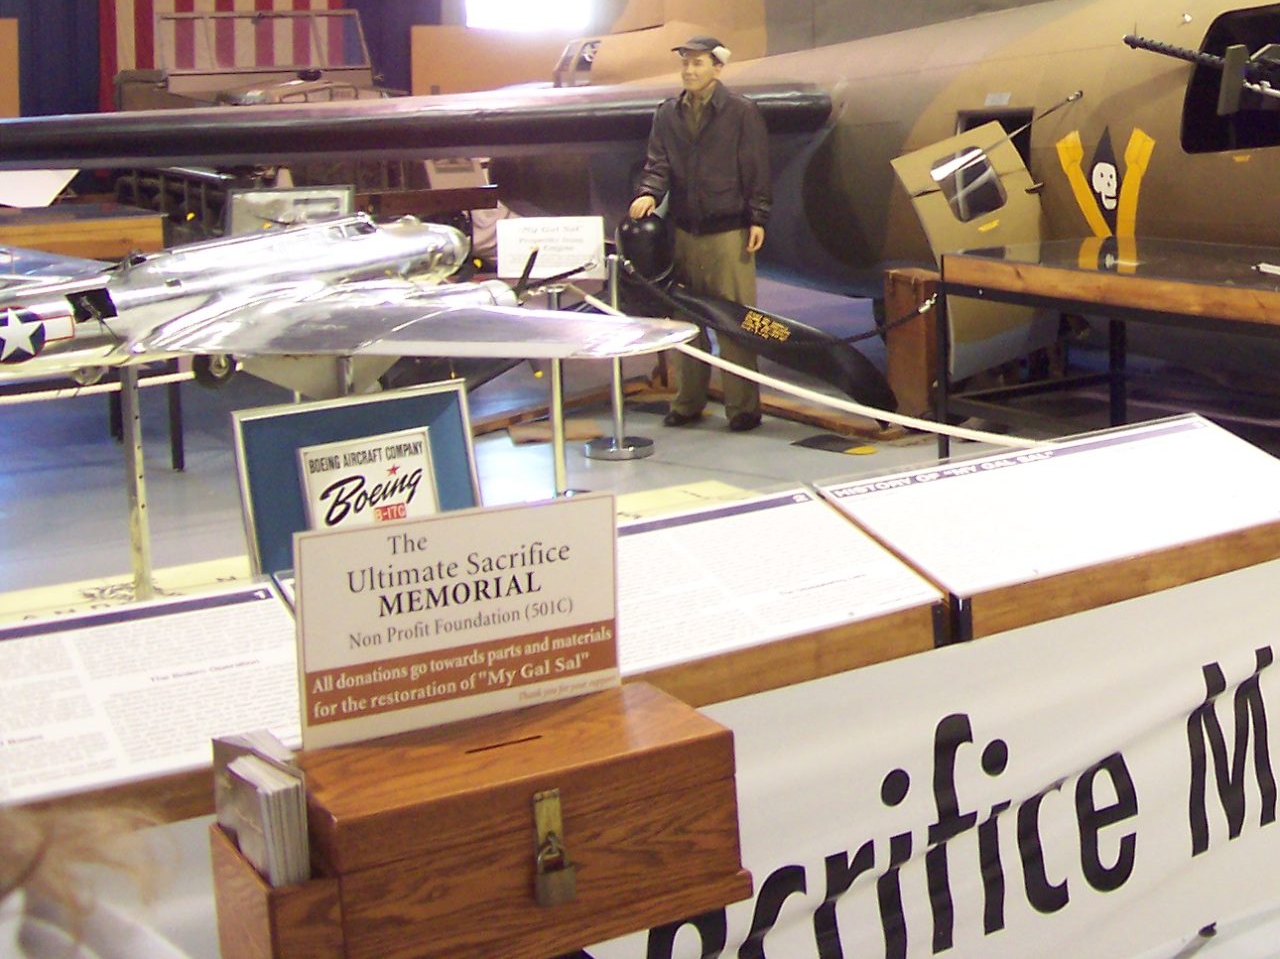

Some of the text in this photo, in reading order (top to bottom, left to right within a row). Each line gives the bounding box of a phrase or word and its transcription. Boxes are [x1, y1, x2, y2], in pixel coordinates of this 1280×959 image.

[309, 441, 423, 474] BOEING AIRCRAFT COMPANY
[319, 467, 423, 527] Boeing
[832, 477, 912, 498] HISTORY
[346, 541, 571, 594] Ultimate Sacrifice
[387, 532, 428, 555] The
[378, 570, 543, 618] MEMORIAL
[349, 596, 574, 650] Non Profit Foundation (501C)
[312, 625, 613, 694] All donations go towards parts and materials
[313, 651, 590, 719] for the restoration of "My Gal Sal"
[556, 713, 1138, 959] crifice
